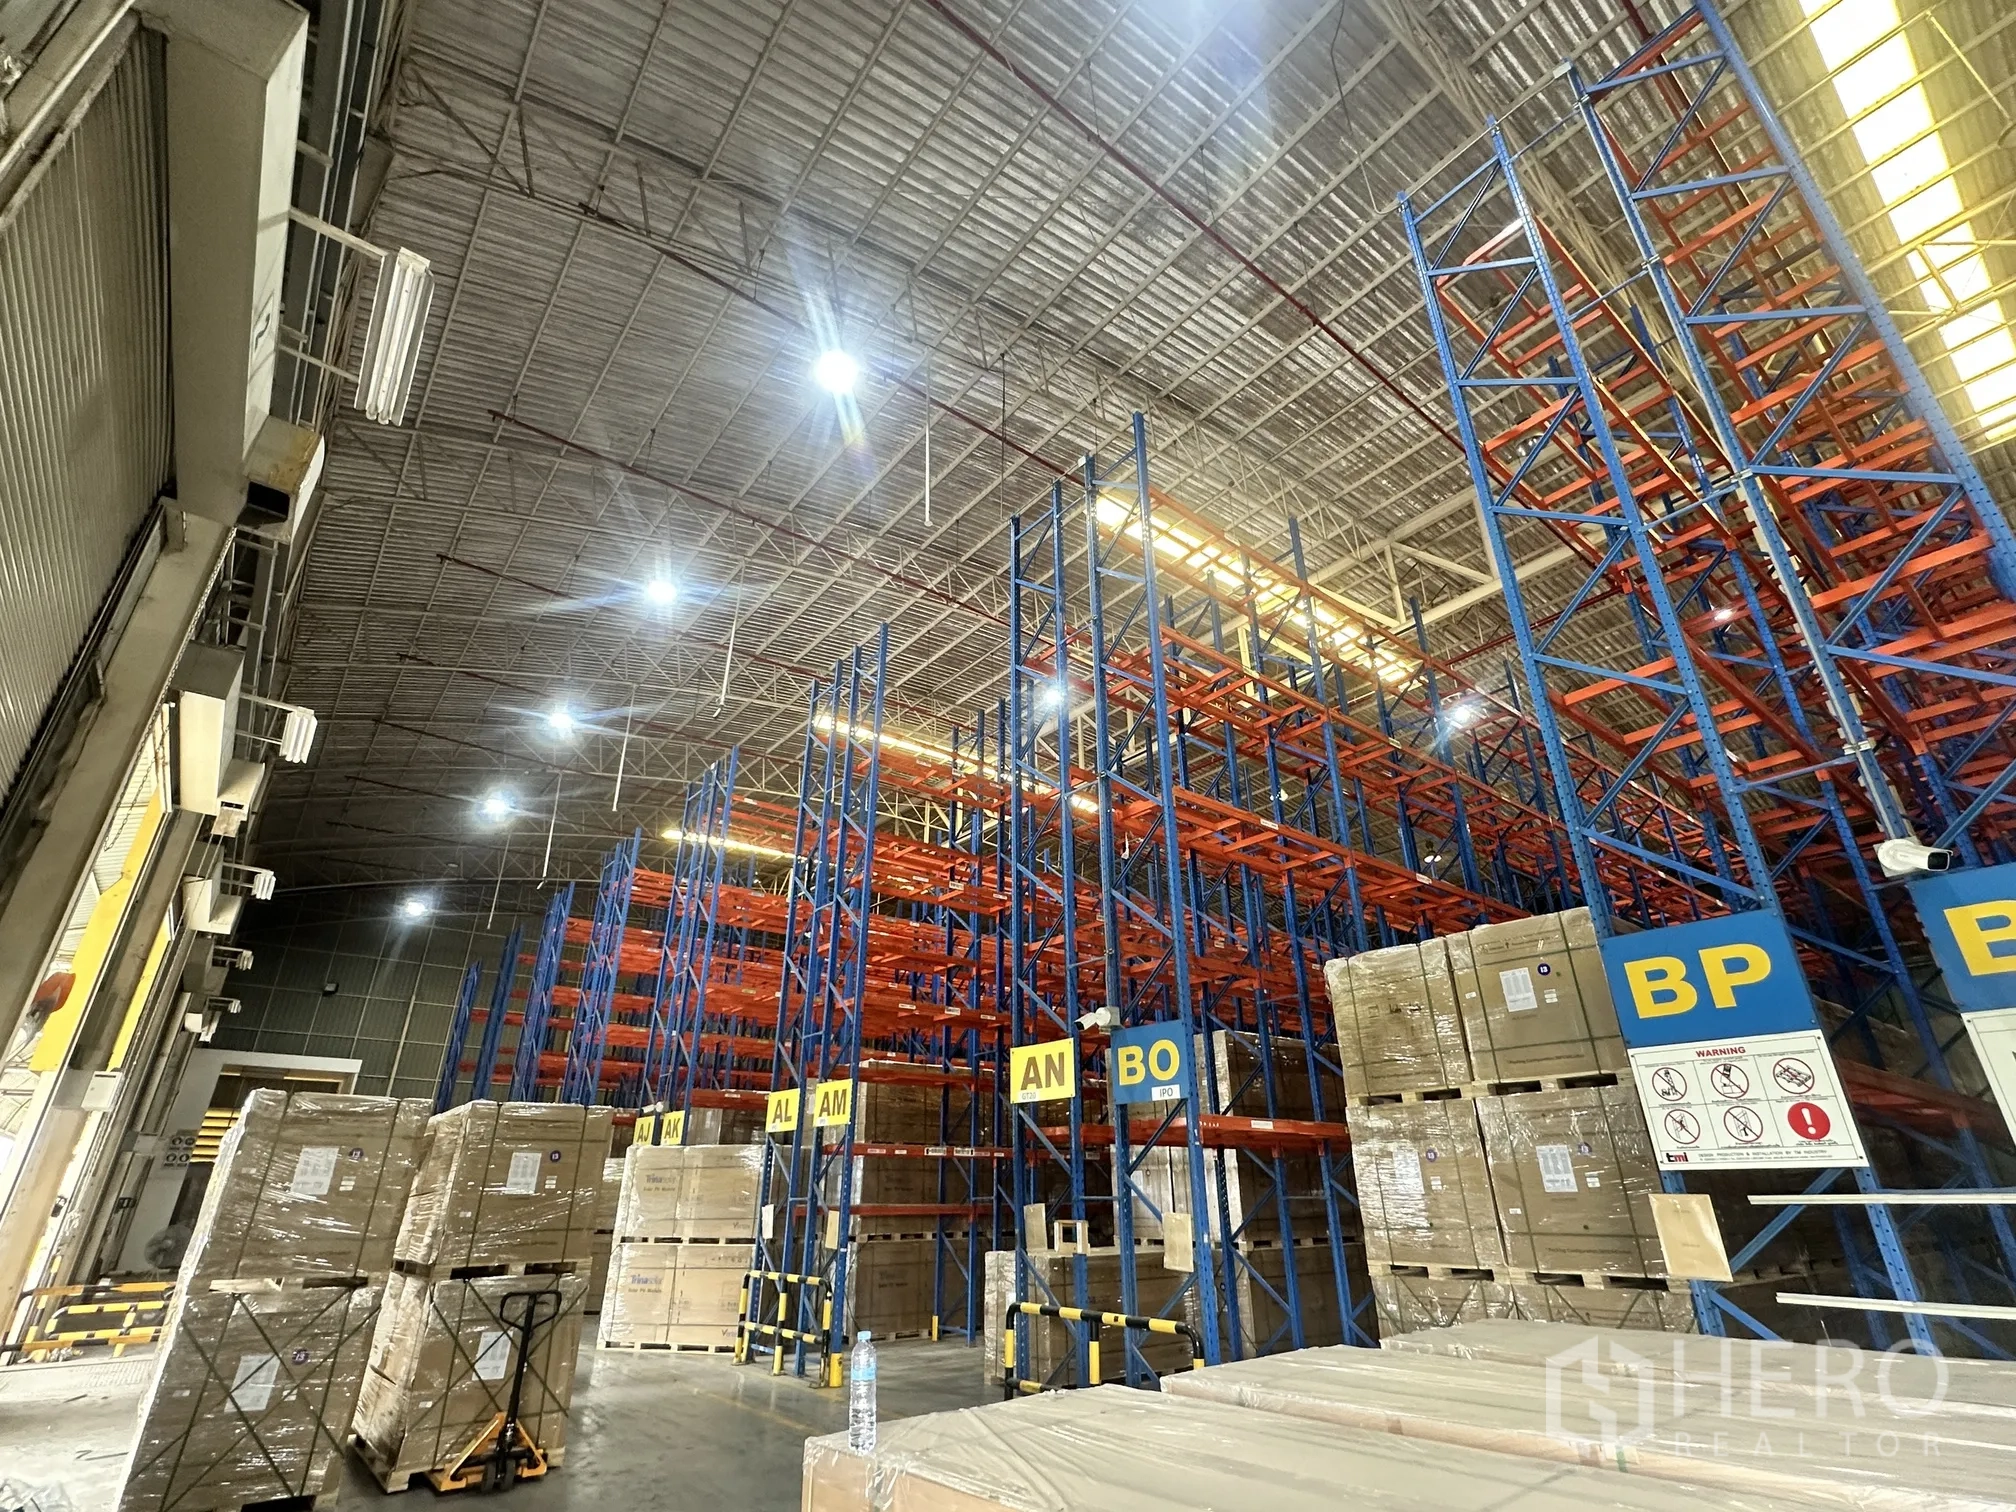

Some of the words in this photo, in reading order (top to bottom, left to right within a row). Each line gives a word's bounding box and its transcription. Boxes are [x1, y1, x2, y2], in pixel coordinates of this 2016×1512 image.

[1624, 943, 1772, 1019] BP
[1117, 1039, 1180, 1086] BO
[1695, 1046, 1747, 1058] WARNING
[1020, 1051, 1065, 1091] AN
[818, 1088, 848, 1118] AM
[1159, 1087, 1174, 1098] IPO
[771, 1098, 793, 1124] AL
[636, 1121, 651, 1143] AJ
[663, 1117, 681, 1140] AK
[1666, 1152, 1689, 1162] tmi
